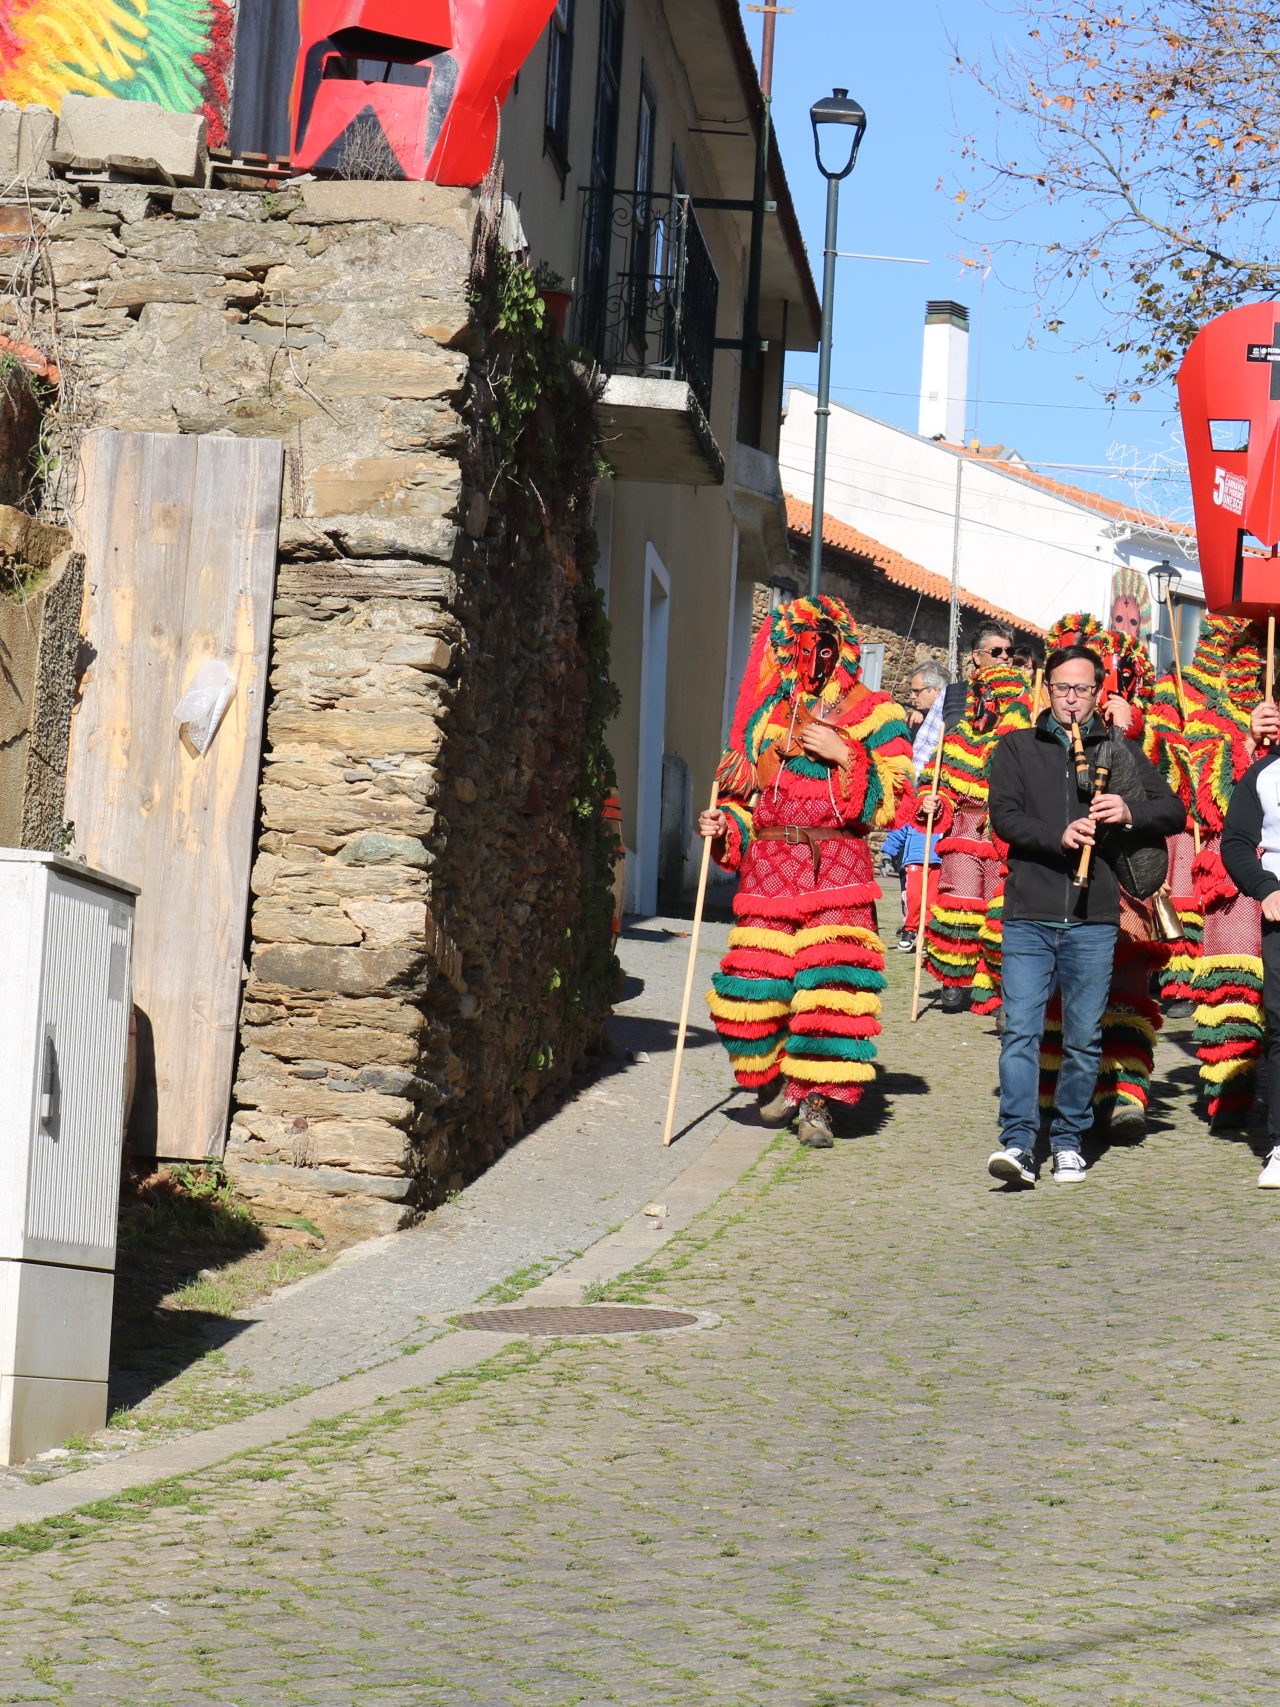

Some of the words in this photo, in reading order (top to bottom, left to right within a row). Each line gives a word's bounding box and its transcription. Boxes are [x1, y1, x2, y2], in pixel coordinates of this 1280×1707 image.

[1213, 467, 1226, 505] 5
[1225, 478, 1246, 494] CARNAVAL
[1222, 493, 1243, 511] UNESCO
